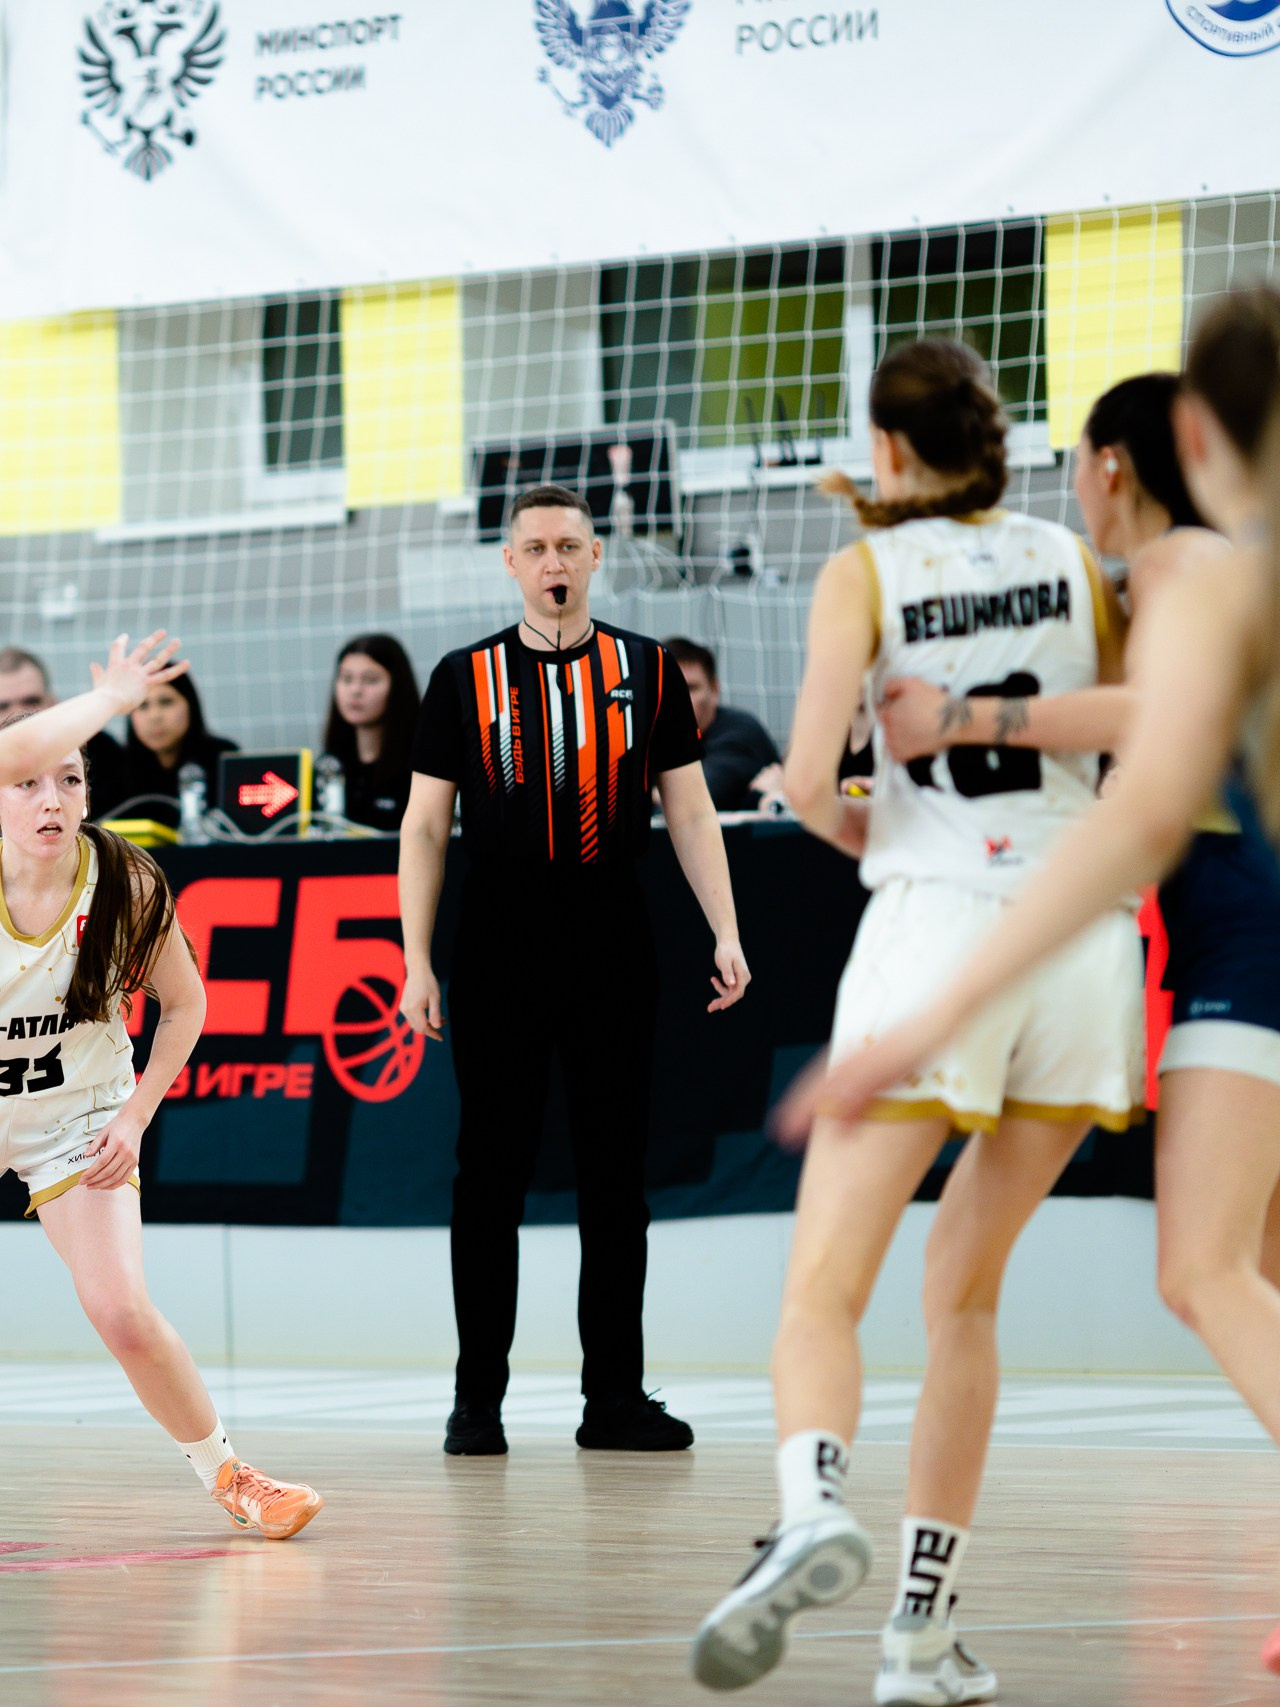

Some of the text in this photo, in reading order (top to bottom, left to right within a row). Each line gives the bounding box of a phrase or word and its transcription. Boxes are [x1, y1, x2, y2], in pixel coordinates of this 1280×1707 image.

[255, 15, 402, 57] МИНСПОРТ
[735, 8, 879, 55] РОССИИ
[1185, 6, 1274, 42] СПОРТИВНЫЙ
[255, 65, 366, 101] РОССИИ
[510, 686, 524, 784] БУДЬ В ИГРЕ
[123, 874, 408, 1037] СБ
[195, 1062, 315, 1099] ИГРЕ
